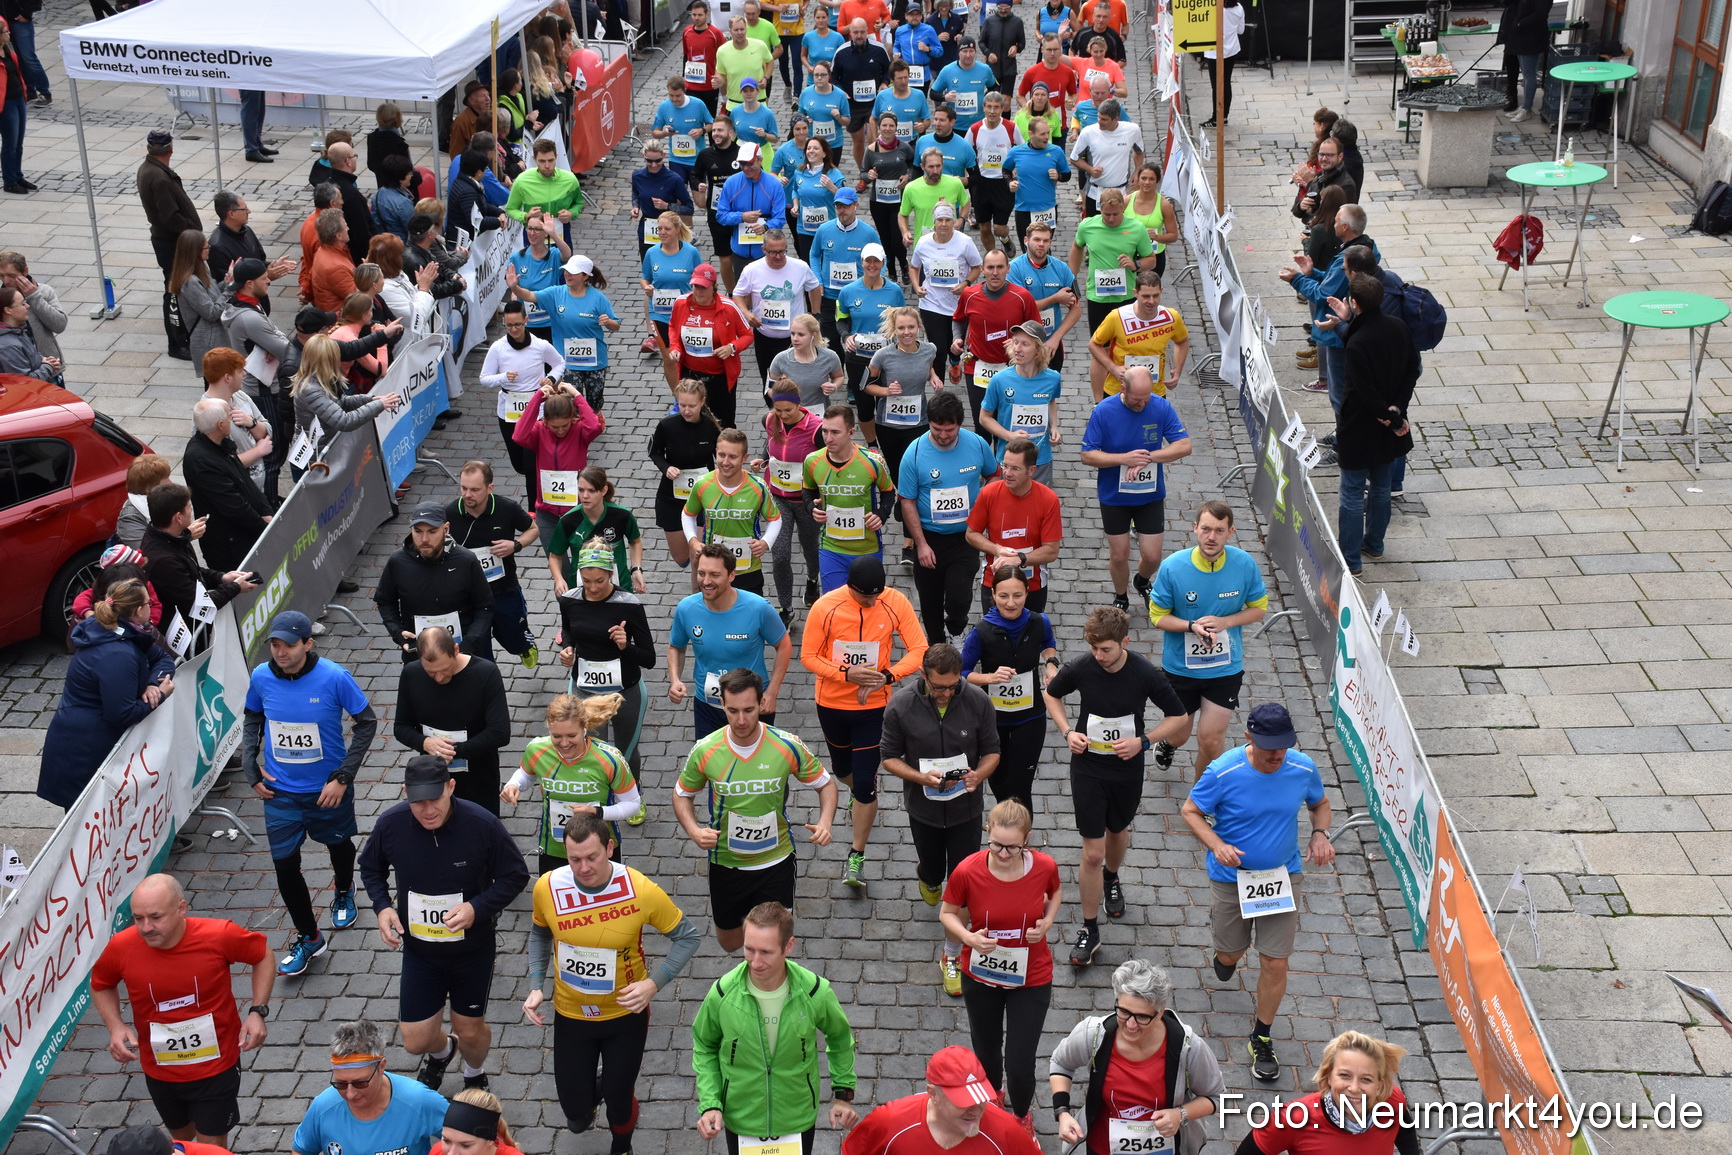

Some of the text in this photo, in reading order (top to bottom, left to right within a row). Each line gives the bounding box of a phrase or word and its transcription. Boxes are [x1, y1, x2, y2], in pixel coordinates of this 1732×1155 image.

[1187, 11, 1210, 22] lauf
[80, 40, 272, 66] BMW ConnectedDrive
[82, 60, 230, 78] Vernetzt, um frei zu sein.
[1035, 213, 1052, 222] 2324
[833, 270, 852, 279] 2125
[1099, 277, 1121, 285] 2264
[764, 309, 785, 318] 2054
[685, 336, 707, 345] 2557
[1126, 326, 1175, 344] MAX BÖGL
[569, 347, 592, 356] 2278
[859, 342, 882, 350] 2265
[891, 404, 916, 414] 2416
[1016, 414, 1043, 425] 2763
[294, 444, 308, 462] swn
[778, 469, 790, 480] 25
[959, 465, 976, 473] BOCK
[1138, 471, 1151, 481] 64
[551, 481, 565, 492] 24
[818, 484, 865, 496] BOCK
[936, 498, 964, 510] 2283
[705, 508, 753, 520] BOCK
[834, 517, 855, 528] 418
[730, 548, 743, 558] 19
[480, 557, 495, 568] 51
[242, 566, 290, 653] BOCK
[171, 626, 184, 649] swn
[843, 653, 867, 666] 305
[584, 671, 613, 684] 2901
[999, 685, 1023, 697] 243
[278, 734, 312, 747] 2143
[1103, 729, 1120, 741] 30
[1337, 717, 1363, 768] Service-Line:
[542, 778, 600, 794] BOCK
[713, 778, 781, 796] BOCK
[735, 826, 771, 840] 2727
[1246, 881, 1283, 899] 2467
[1254, 901, 1280, 909] Wolfgang
[558, 904, 640, 931] MAX BÖGL
[566, 959, 606, 977] 2625
[978, 954, 1018, 973] 2544
[1490, 994, 1514, 1043] Neumarkts
[36, 988, 90, 1074] Service-Line:
[166, 1034, 202, 1051] 213
[1129, 1107, 1144, 1116] DEHN
[1119, 1137, 1165, 1152] 2543
